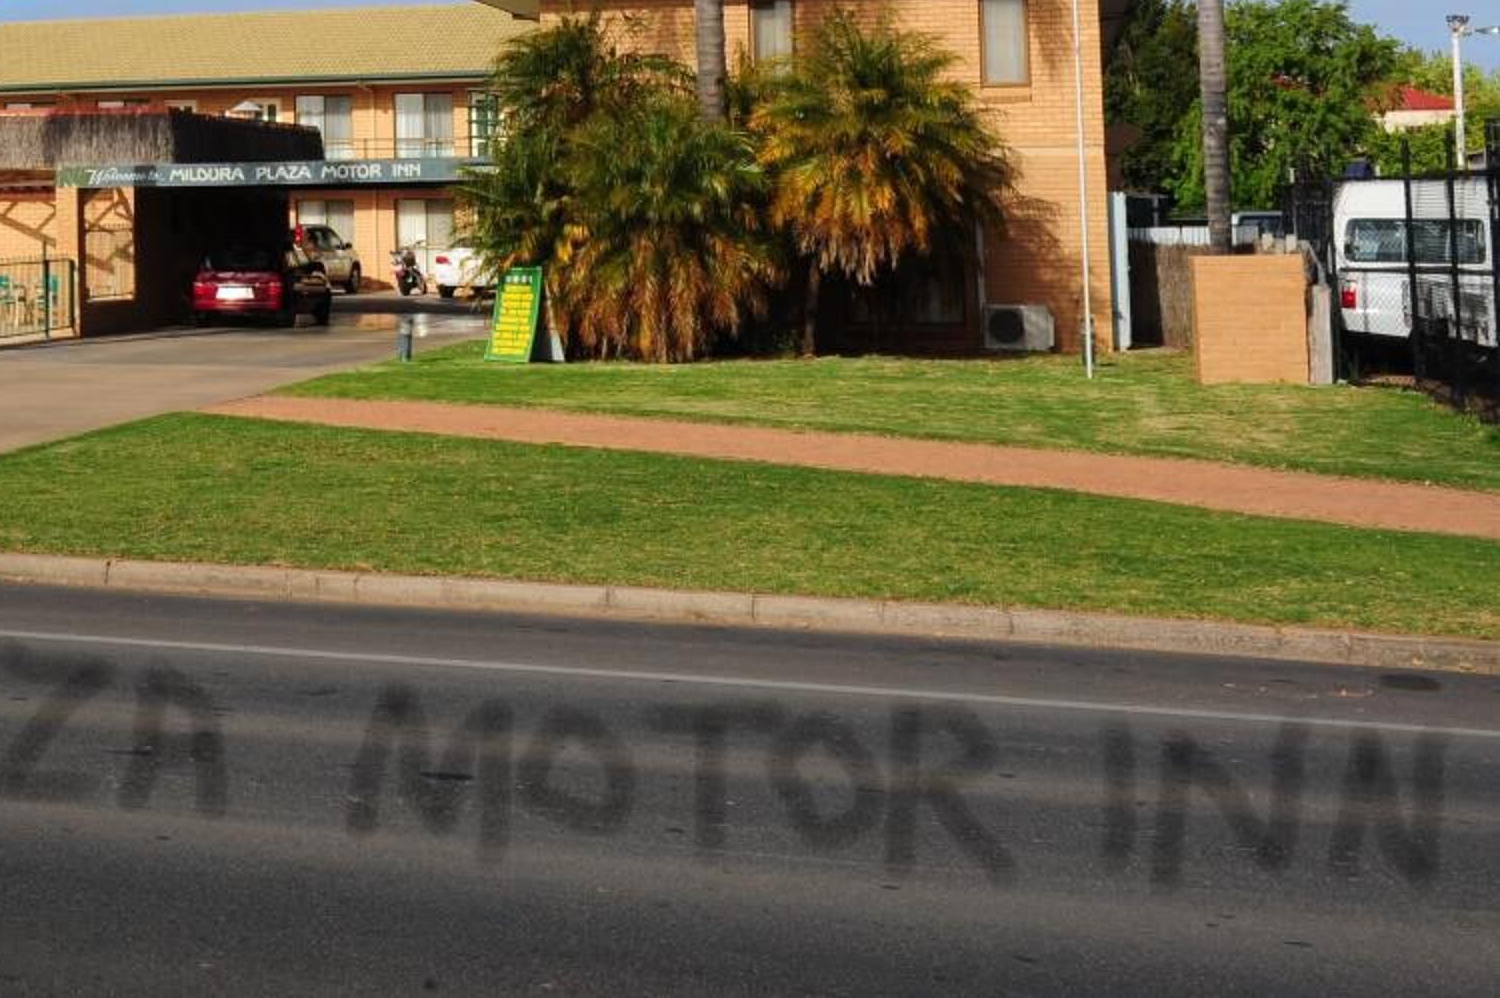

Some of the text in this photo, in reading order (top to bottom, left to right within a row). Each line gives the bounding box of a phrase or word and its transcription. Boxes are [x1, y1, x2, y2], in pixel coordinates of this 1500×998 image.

[169, 167, 244, 182] MILDURA
[256, 165, 312, 180] PLAZA
[321, 164, 383, 180] MOTOR
[392, 163, 421, 178] INN
[346, 679, 1018, 886] MOTOR
[1102, 720, 1449, 890] INN
